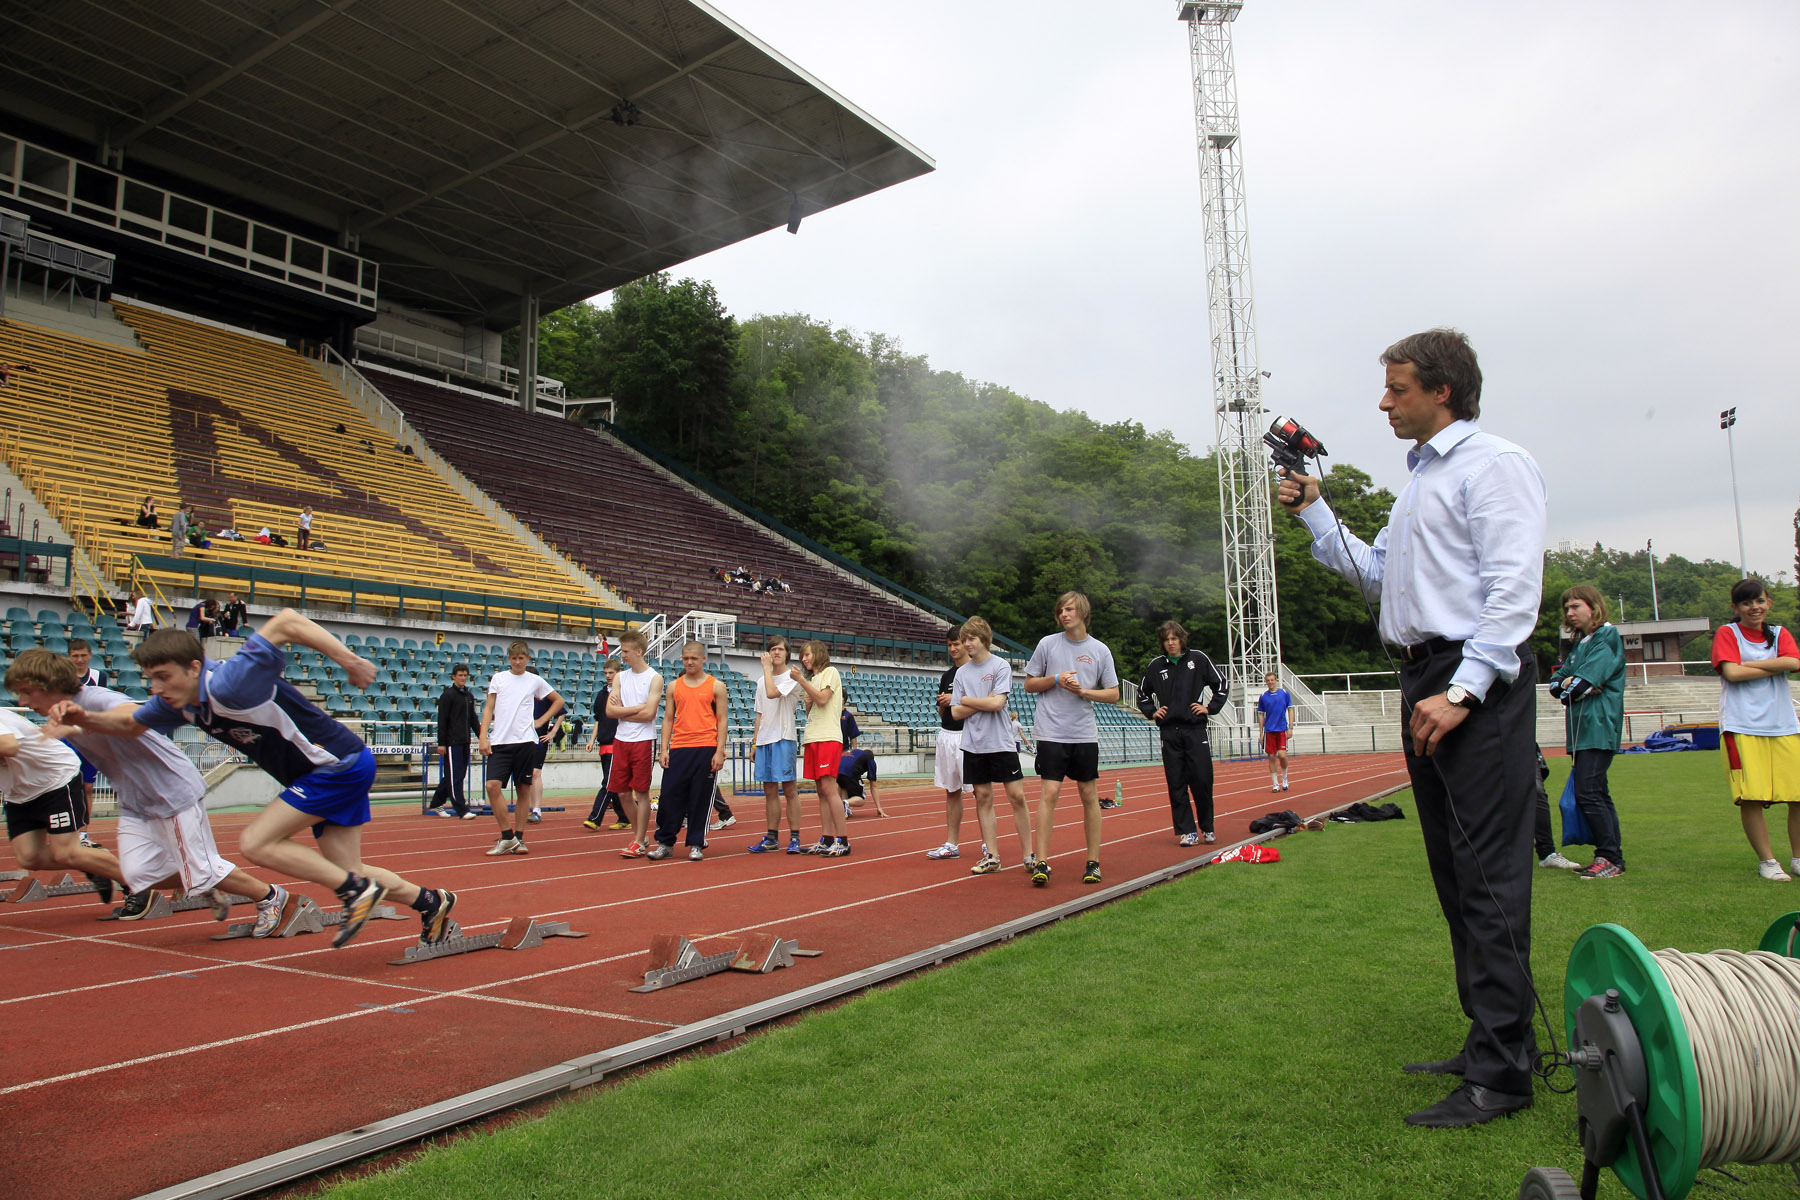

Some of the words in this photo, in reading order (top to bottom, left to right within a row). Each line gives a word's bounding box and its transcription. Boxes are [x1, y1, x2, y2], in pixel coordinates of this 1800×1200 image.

[436, 633, 444, 645] F
[1626, 637, 1640, 645] WC
[49, 811, 71, 829] 53
